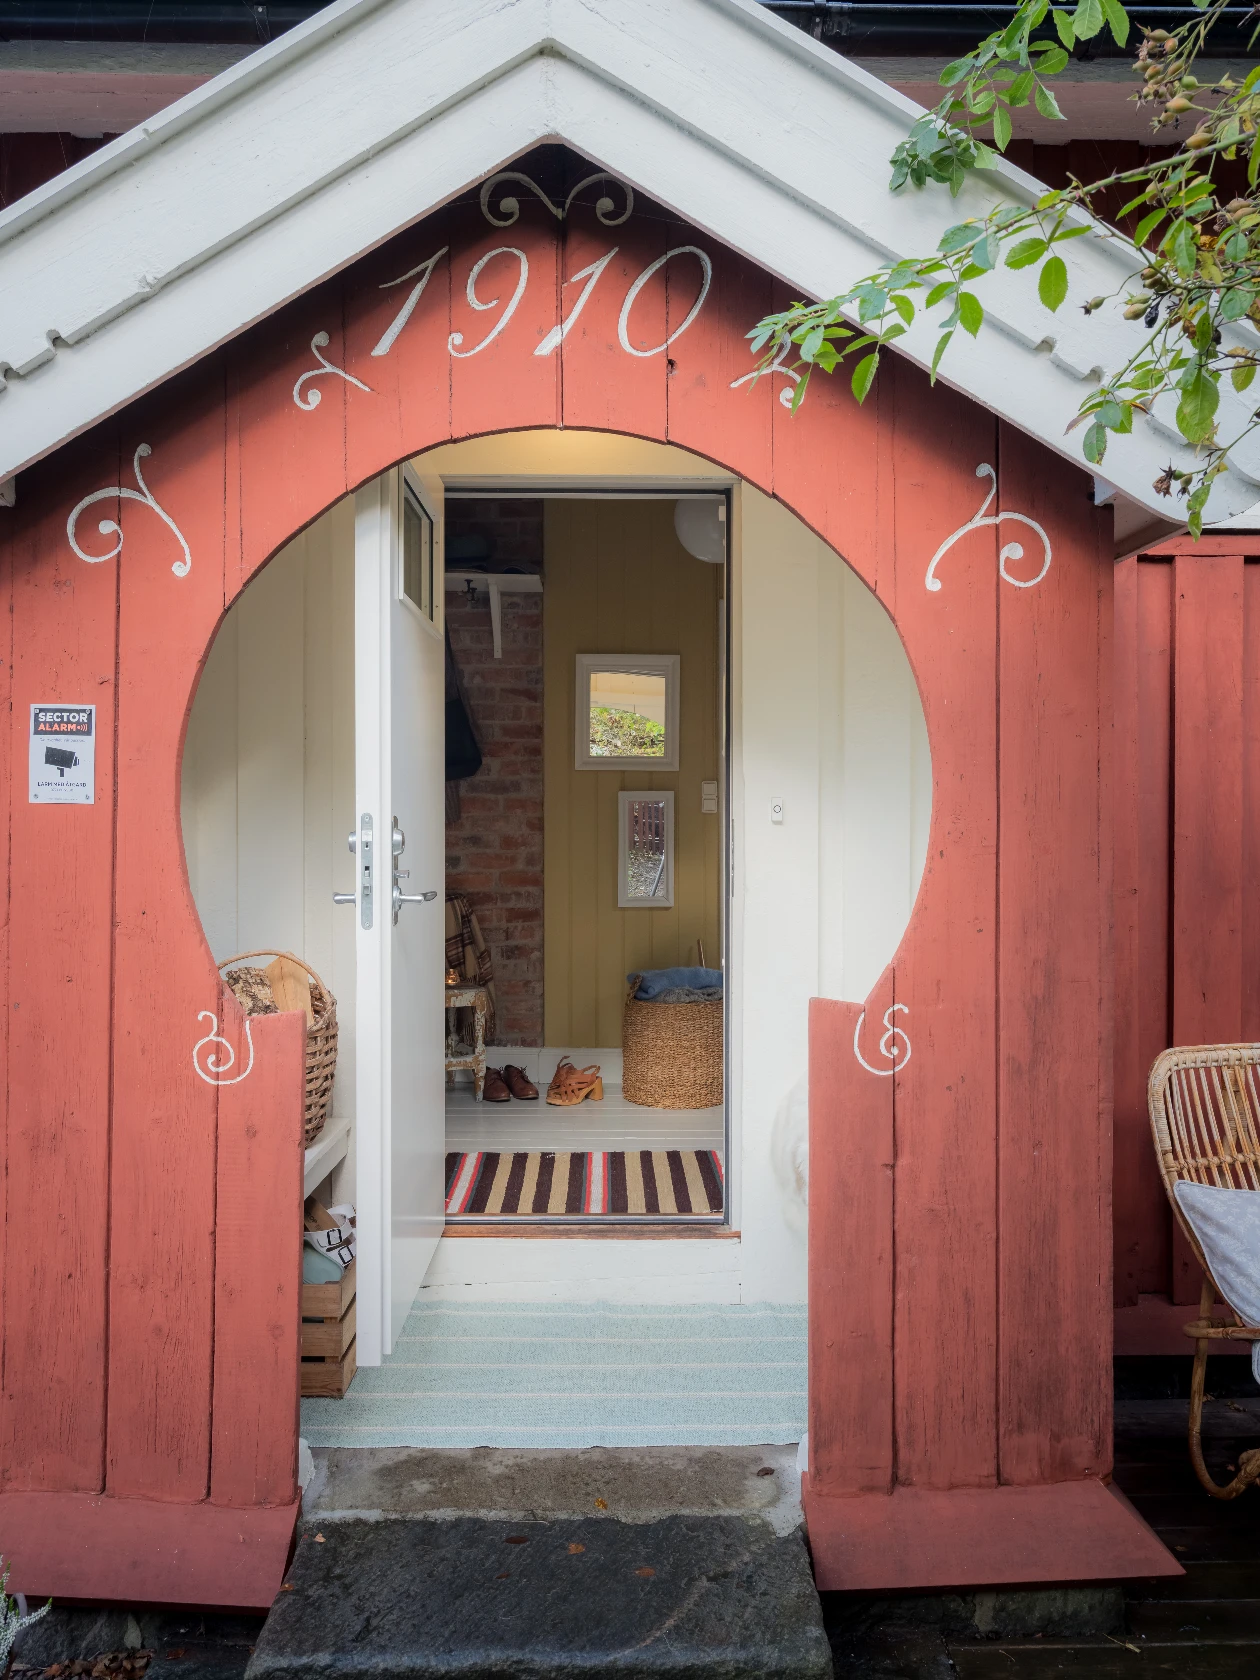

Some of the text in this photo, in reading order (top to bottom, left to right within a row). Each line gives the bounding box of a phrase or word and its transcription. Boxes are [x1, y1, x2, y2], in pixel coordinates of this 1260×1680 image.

[370, 245, 713, 358] 1910
[38, 712, 88, 723] SECTOR
[37, 722, 77, 732] ALARM
